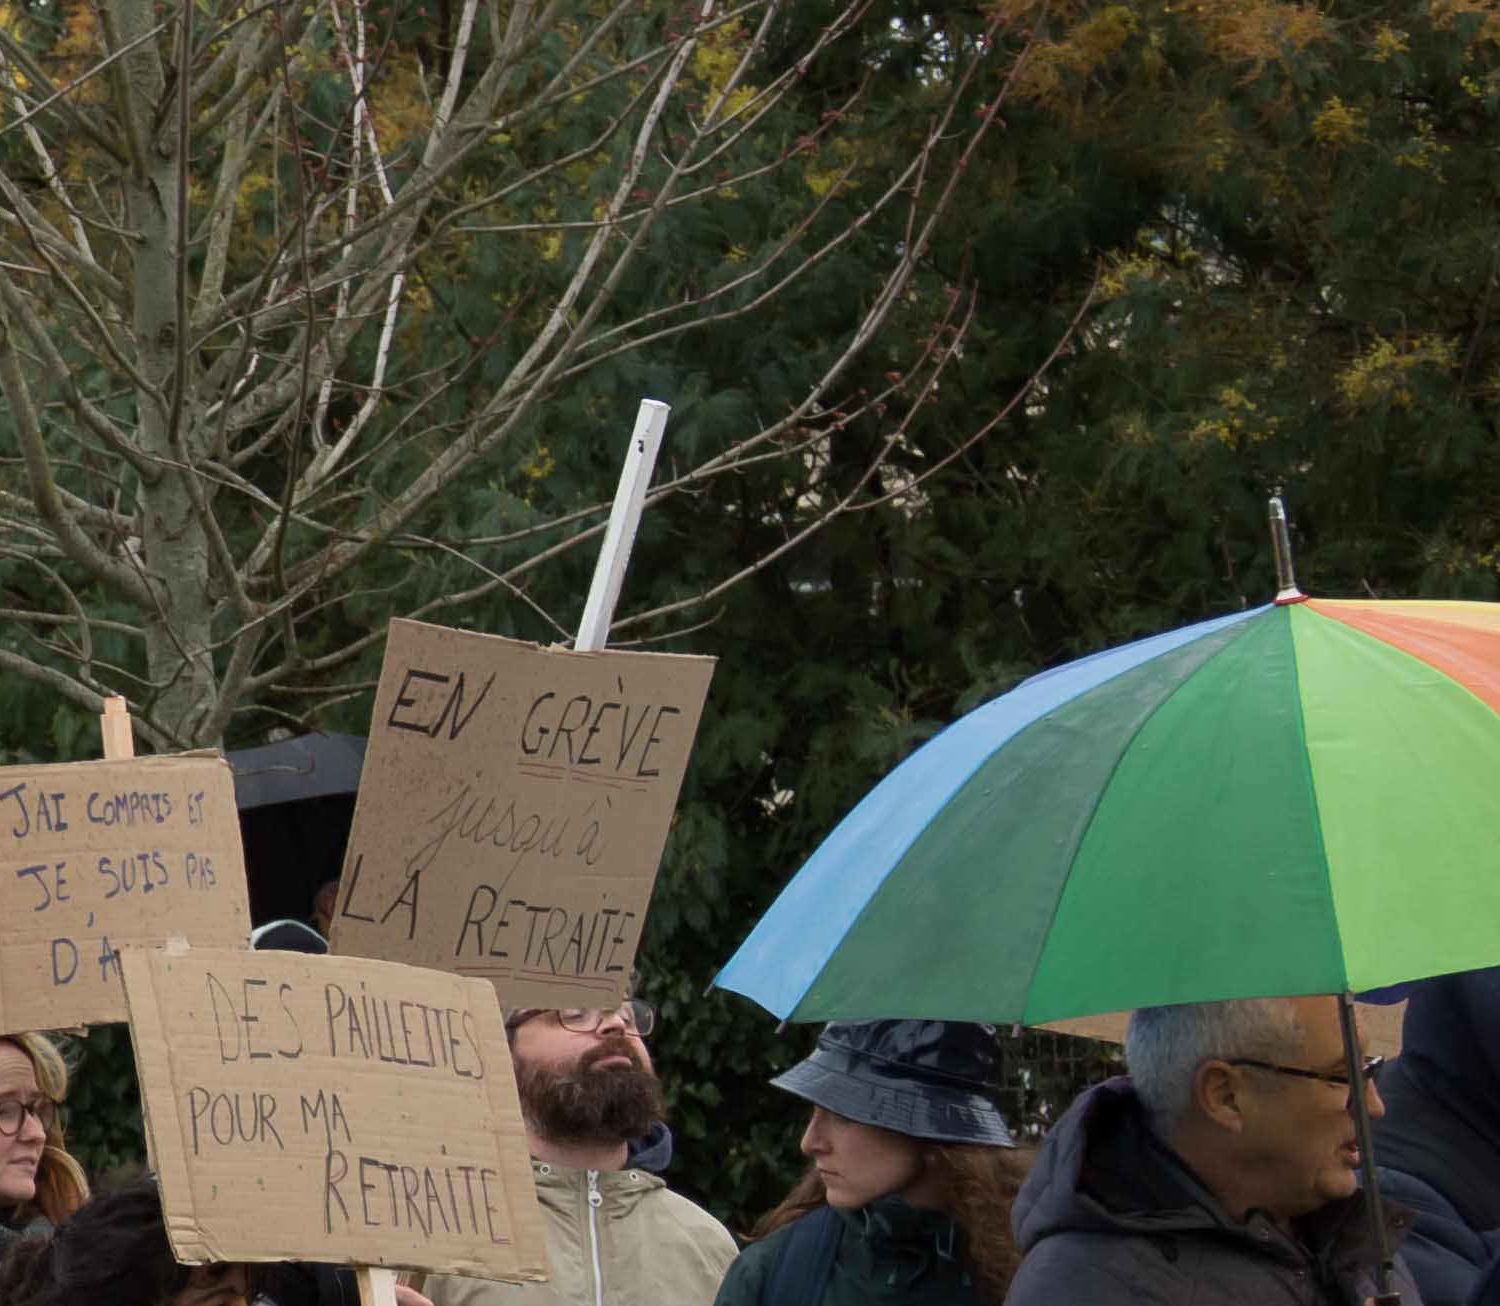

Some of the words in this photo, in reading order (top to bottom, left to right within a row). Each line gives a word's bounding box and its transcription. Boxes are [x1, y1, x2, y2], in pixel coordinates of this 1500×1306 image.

[387, 669, 497, 740] EN
[521, 673, 680, 777] GRÈVE
[86, 791, 171, 826] COMPRIS
[187, 791, 204, 824] ET
[17, 863, 70, 911] JE
[98, 852, 168, 899] SUIS
[186, 852, 217, 889] PAS
[340, 853, 421, 940] LA
[455, 884, 636, 976] RETRAITE
[206, 971, 303, 1065] DES
[324, 982, 485, 1080] PAILLETTES
[188, 1086, 284, 1155] POUR
[300, 1088, 352, 1152] MA
[323, 1144, 511, 1245] RETRAITE
